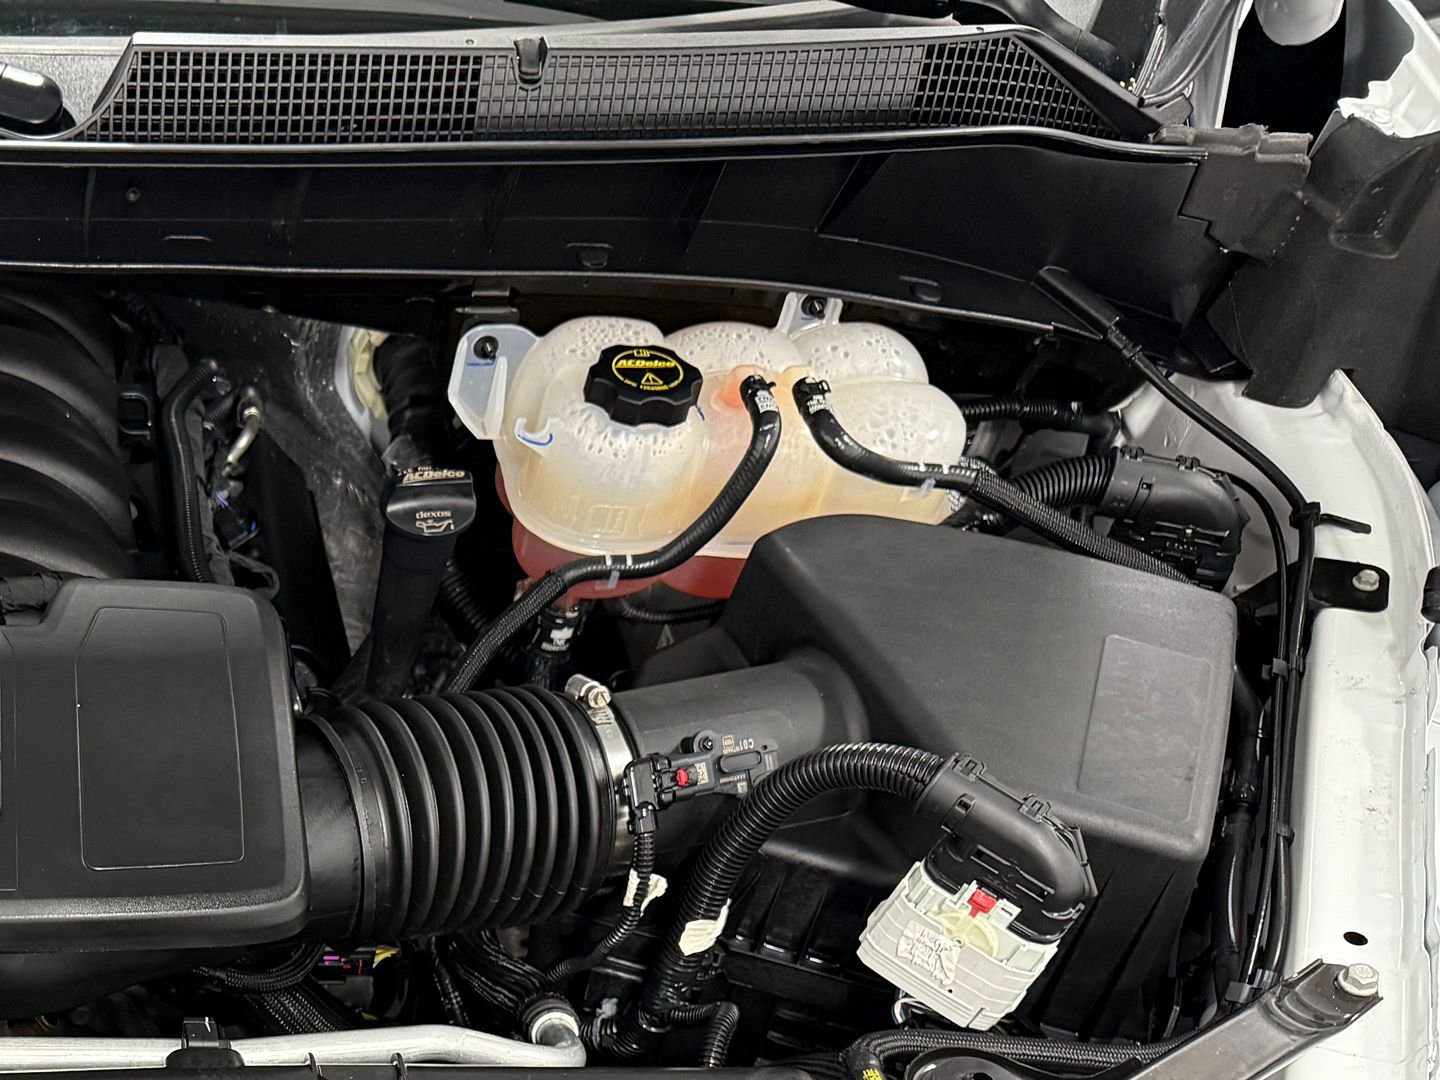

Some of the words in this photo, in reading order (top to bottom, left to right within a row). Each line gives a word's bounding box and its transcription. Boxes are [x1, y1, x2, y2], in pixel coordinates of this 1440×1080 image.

[616, 359, 676, 368] ACDelco
[403, 469, 465, 485] ACDelco
[415, 511, 452, 519] dexos
